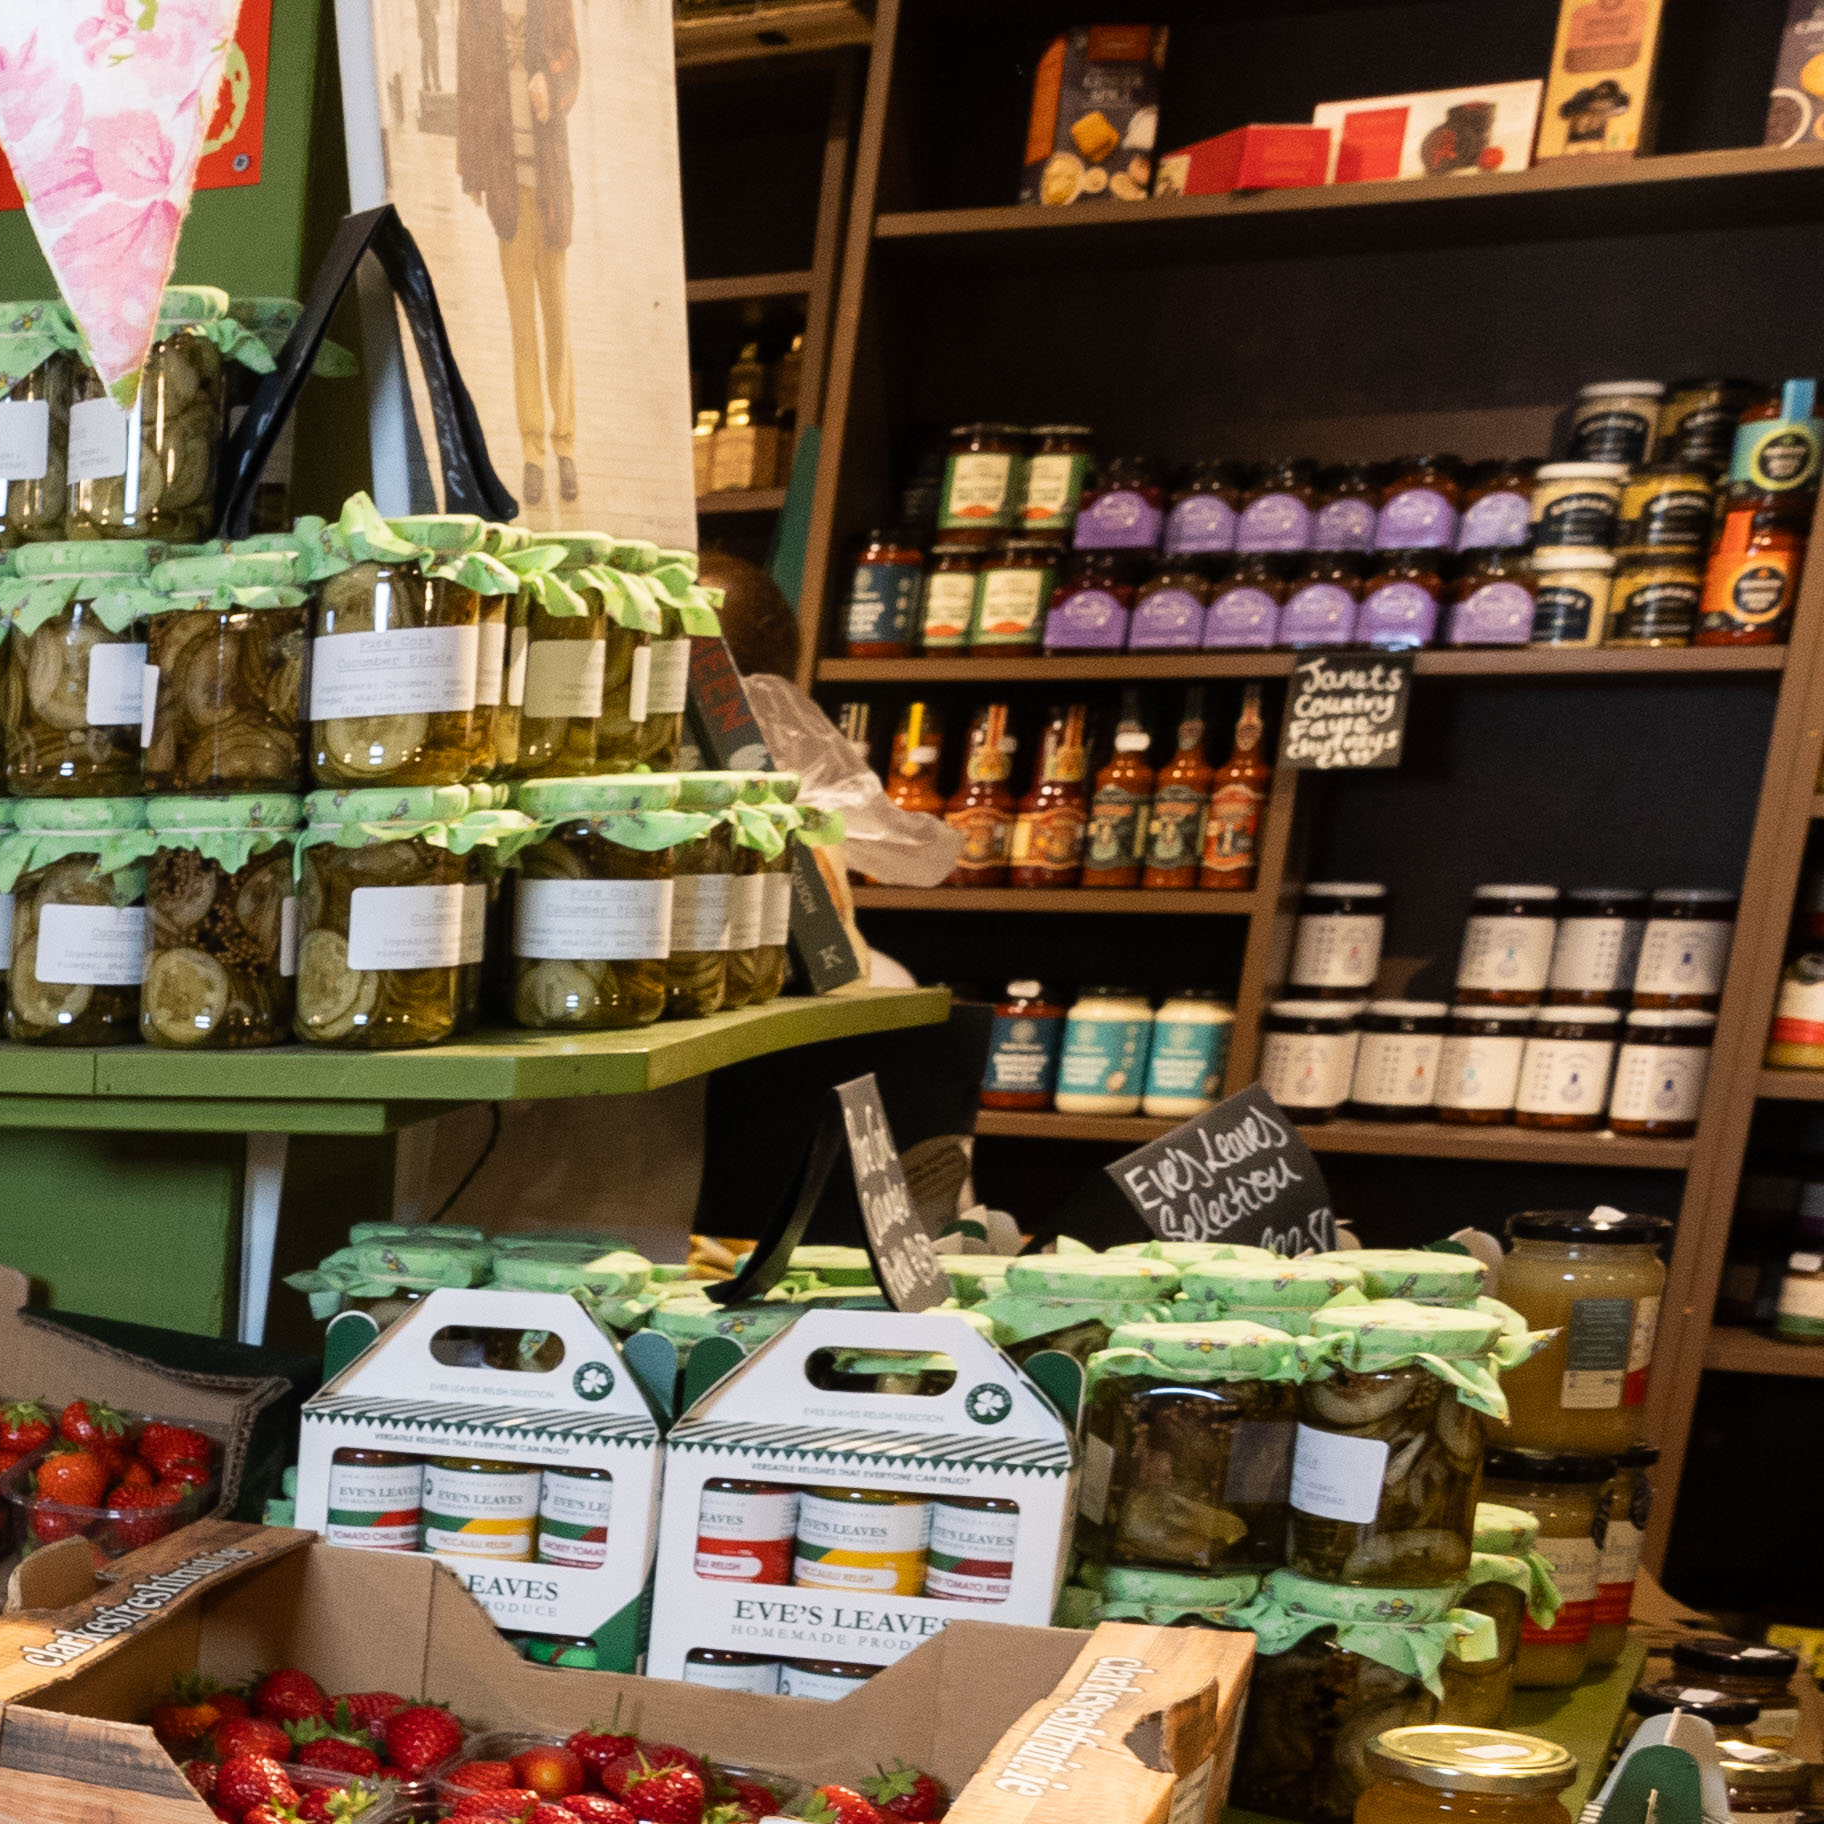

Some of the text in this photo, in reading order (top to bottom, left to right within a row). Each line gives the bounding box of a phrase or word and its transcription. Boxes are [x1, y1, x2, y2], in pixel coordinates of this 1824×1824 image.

[1293, 692, 1396, 724] Country
[1161, 1156, 1303, 1243] Selection
[451, 1438, 473, 1449] THAT
[475, 1440, 520, 1453] EVERYONE
[520, 1445, 541, 1454] CAN
[542, 1446, 570, 1457] ENJOY
[750, 1462, 972, 1487] VERSATILE RELISHES THAT EVERYONE CAN ENJOY
[438, 1489, 523, 1506] EVE'S LEAVES
[698, 1511, 744, 1526] EAVES
[333, 1529, 370, 1541] TOMATO
[834, 1522, 888, 1538] LEAVES
[963, 1531, 1015, 1546] LEAVES
[482, 1600, 558, 1617] RODUCE
[735, 1599, 823, 1627] EVE'S
[731, 1623, 920, 1651] HOMEMADE PROD
